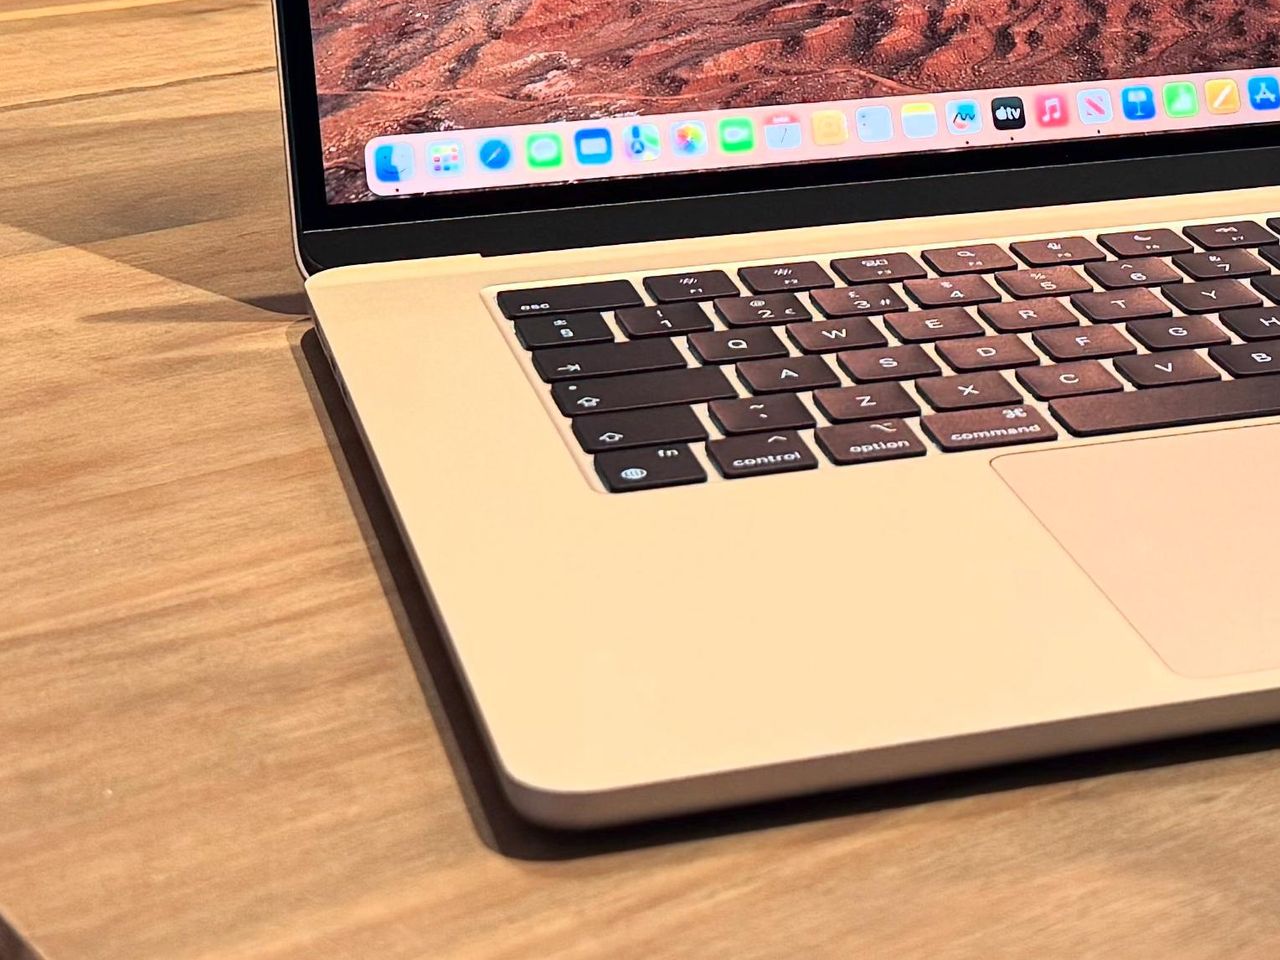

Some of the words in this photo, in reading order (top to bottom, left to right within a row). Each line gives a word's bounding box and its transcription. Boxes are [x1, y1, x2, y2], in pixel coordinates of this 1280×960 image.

[1130, 272, 1147, 281] 6
[1200, 290, 1217, 300] Y
[853, 300, 871, 309] 3
[1110, 299, 1126, 309] T
[757, 309, 775, 319] 2
[1018, 309, 1038, 320] R
[924, 318, 944, 329] E
[821, 328, 847, 339] W
[1168, 327, 1188, 337] G
[727, 339, 748, 349] Q
[1075, 336, 1091, 347] F
[976, 347, 997, 357] D
[1251, 352, 1272, 363] B
[878, 357, 898, 368] S
[1154, 362, 1173, 373] V
[780, 368, 799, 379] A
[1058, 373, 1079, 384] C
[957, 384, 980, 396] X
[855, 395, 877, 407] Z
[951, 425, 1040, 440] command
[849, 440, 910, 453] option
[657, 449, 679, 458] fn
[732, 451, 801, 467] control
